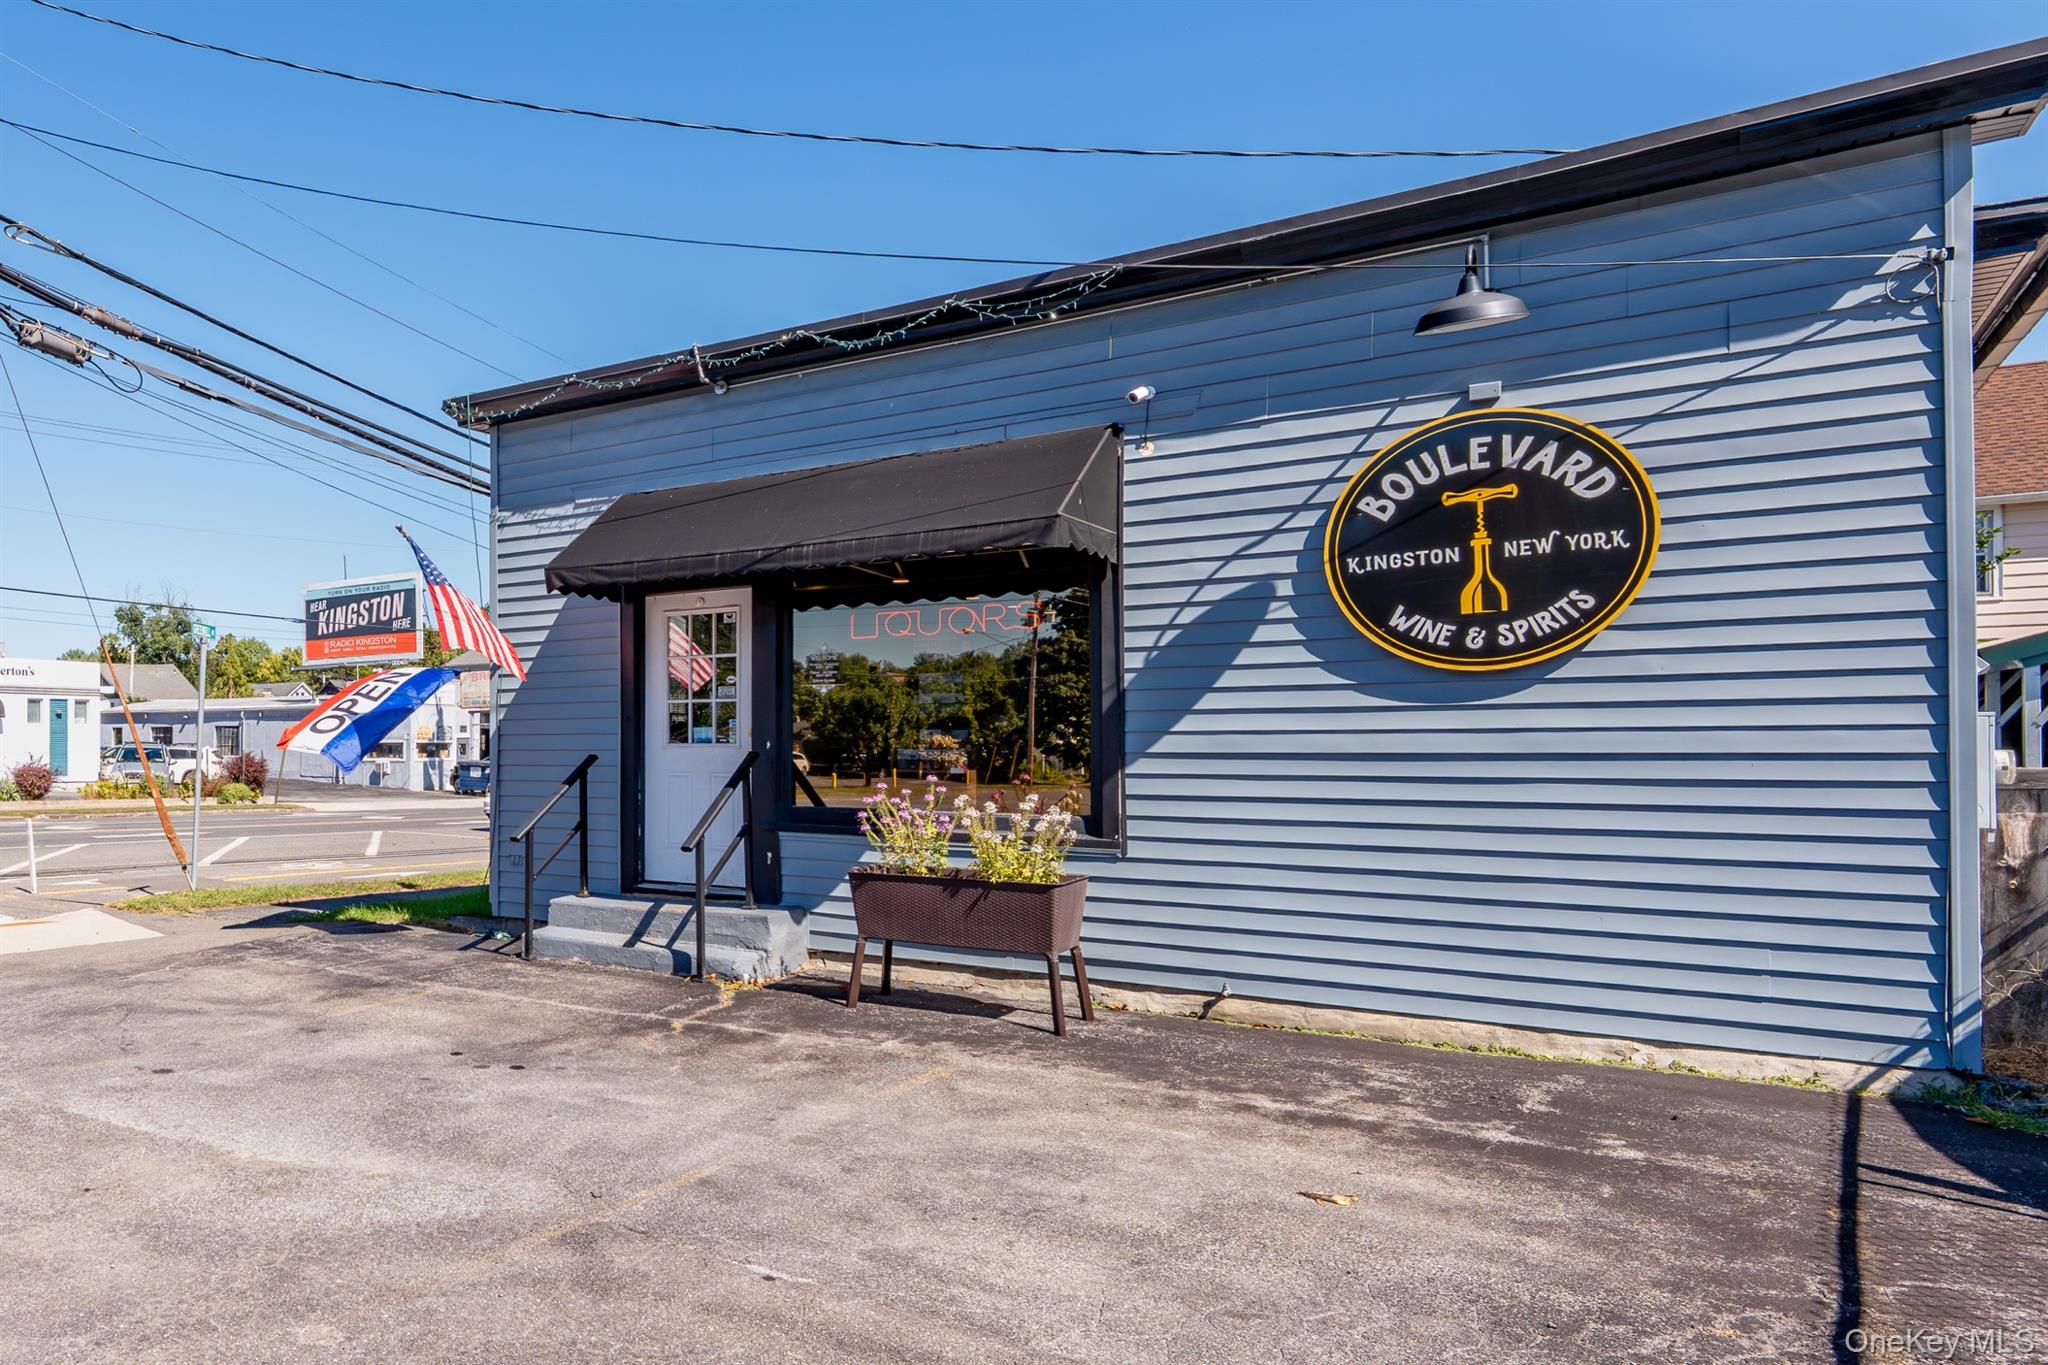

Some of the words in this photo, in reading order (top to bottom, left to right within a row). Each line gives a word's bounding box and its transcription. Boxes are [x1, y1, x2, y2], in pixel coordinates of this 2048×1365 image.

[1356, 434, 1616, 522] BOULEVARD
[1347, 547, 1460, 574] KINGSTON
[1504, 530, 1560, 557] NEW
[1566, 529, 1630, 551] YORK
[310, 600, 327, 613] HEAR
[318, 592, 405, 636] KINGSTON
[392, 617, 411, 631] HERE
[1389, 605, 1456, 647] WINE
[1465, 627, 1486, 649] &
[1498, 590, 1596, 646] SPIRITS
[330, 639, 354, 648] RADIO
[355, 636, 397, 646] KINGSTON
[309, 672, 413, 734] OPEN
